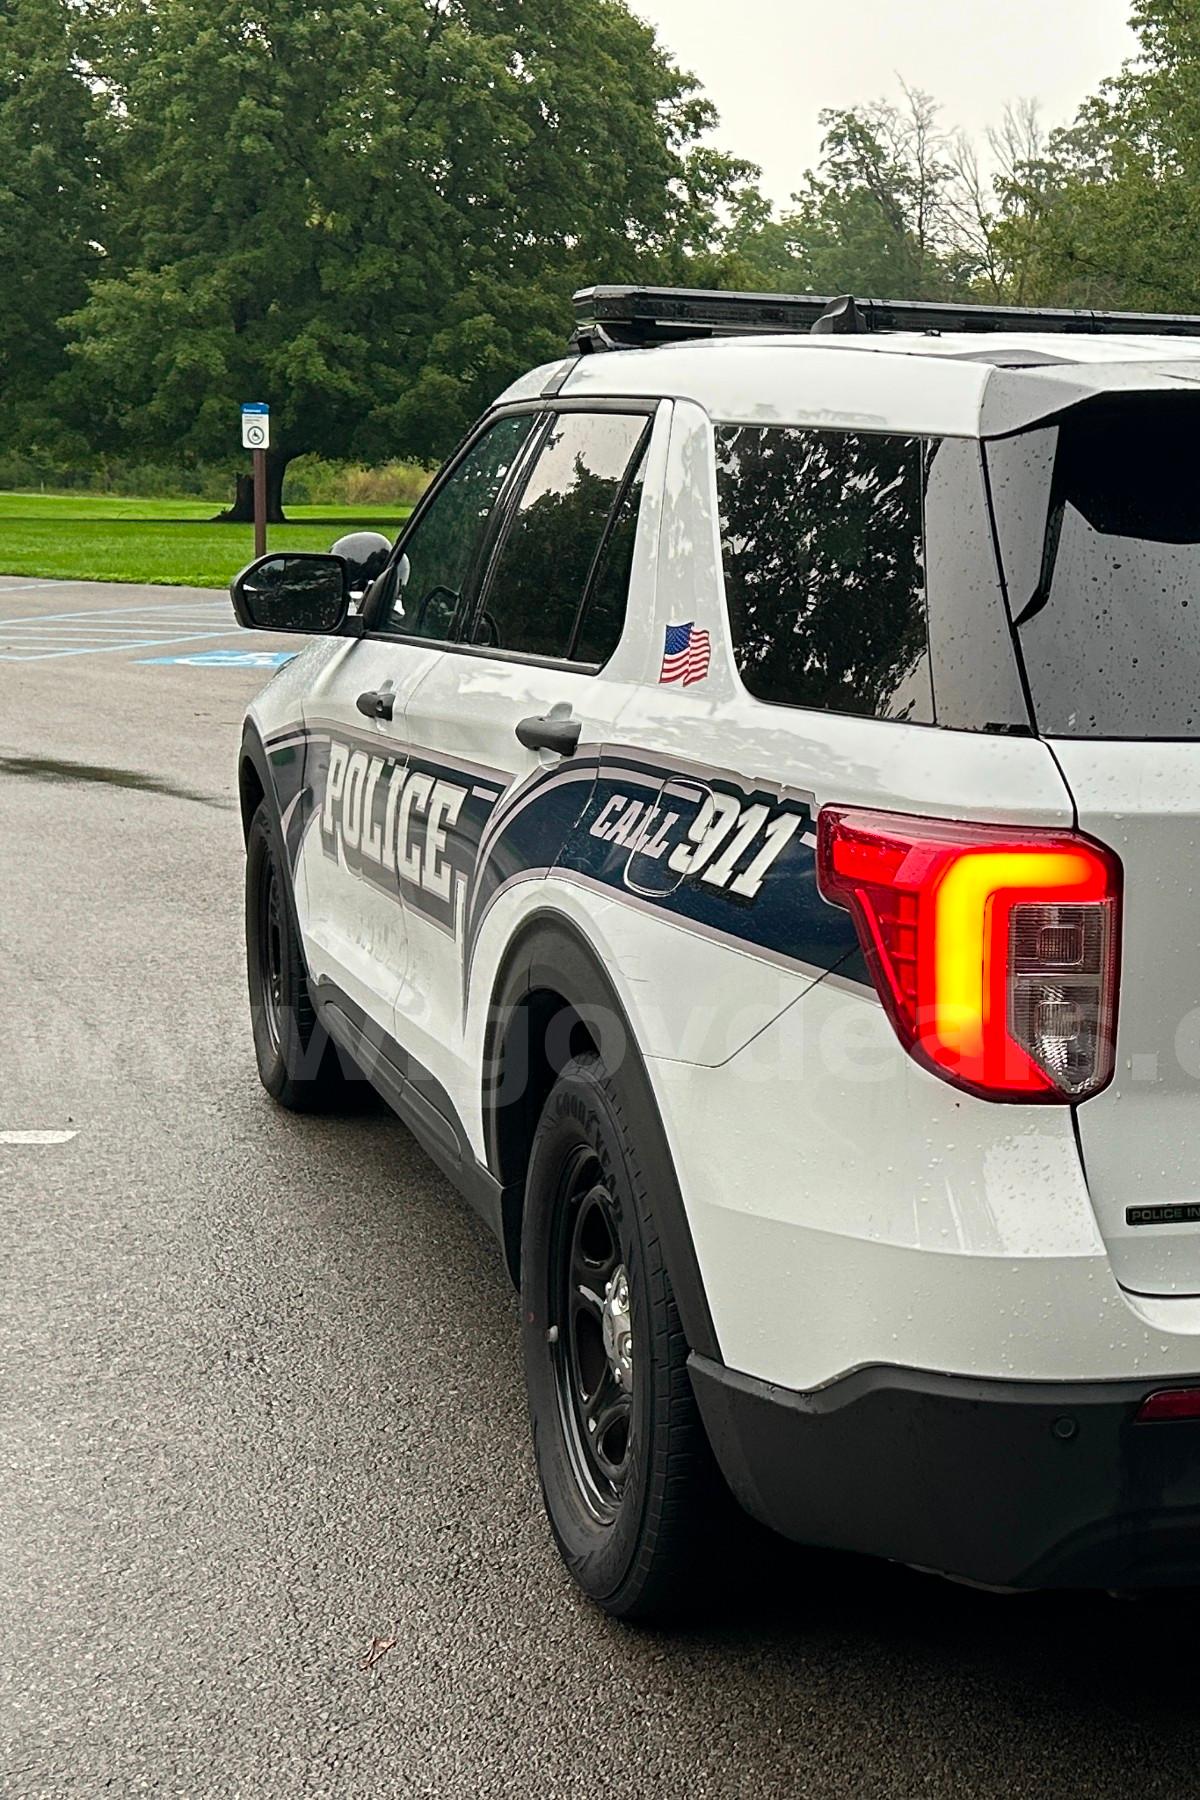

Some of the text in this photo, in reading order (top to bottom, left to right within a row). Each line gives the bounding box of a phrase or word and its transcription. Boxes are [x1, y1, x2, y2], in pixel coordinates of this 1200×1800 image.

[323, 739, 468, 903] POLICE
[590, 791, 802, 898] CALL 911
[1131, 1208, 1183, 1221] POLICE
